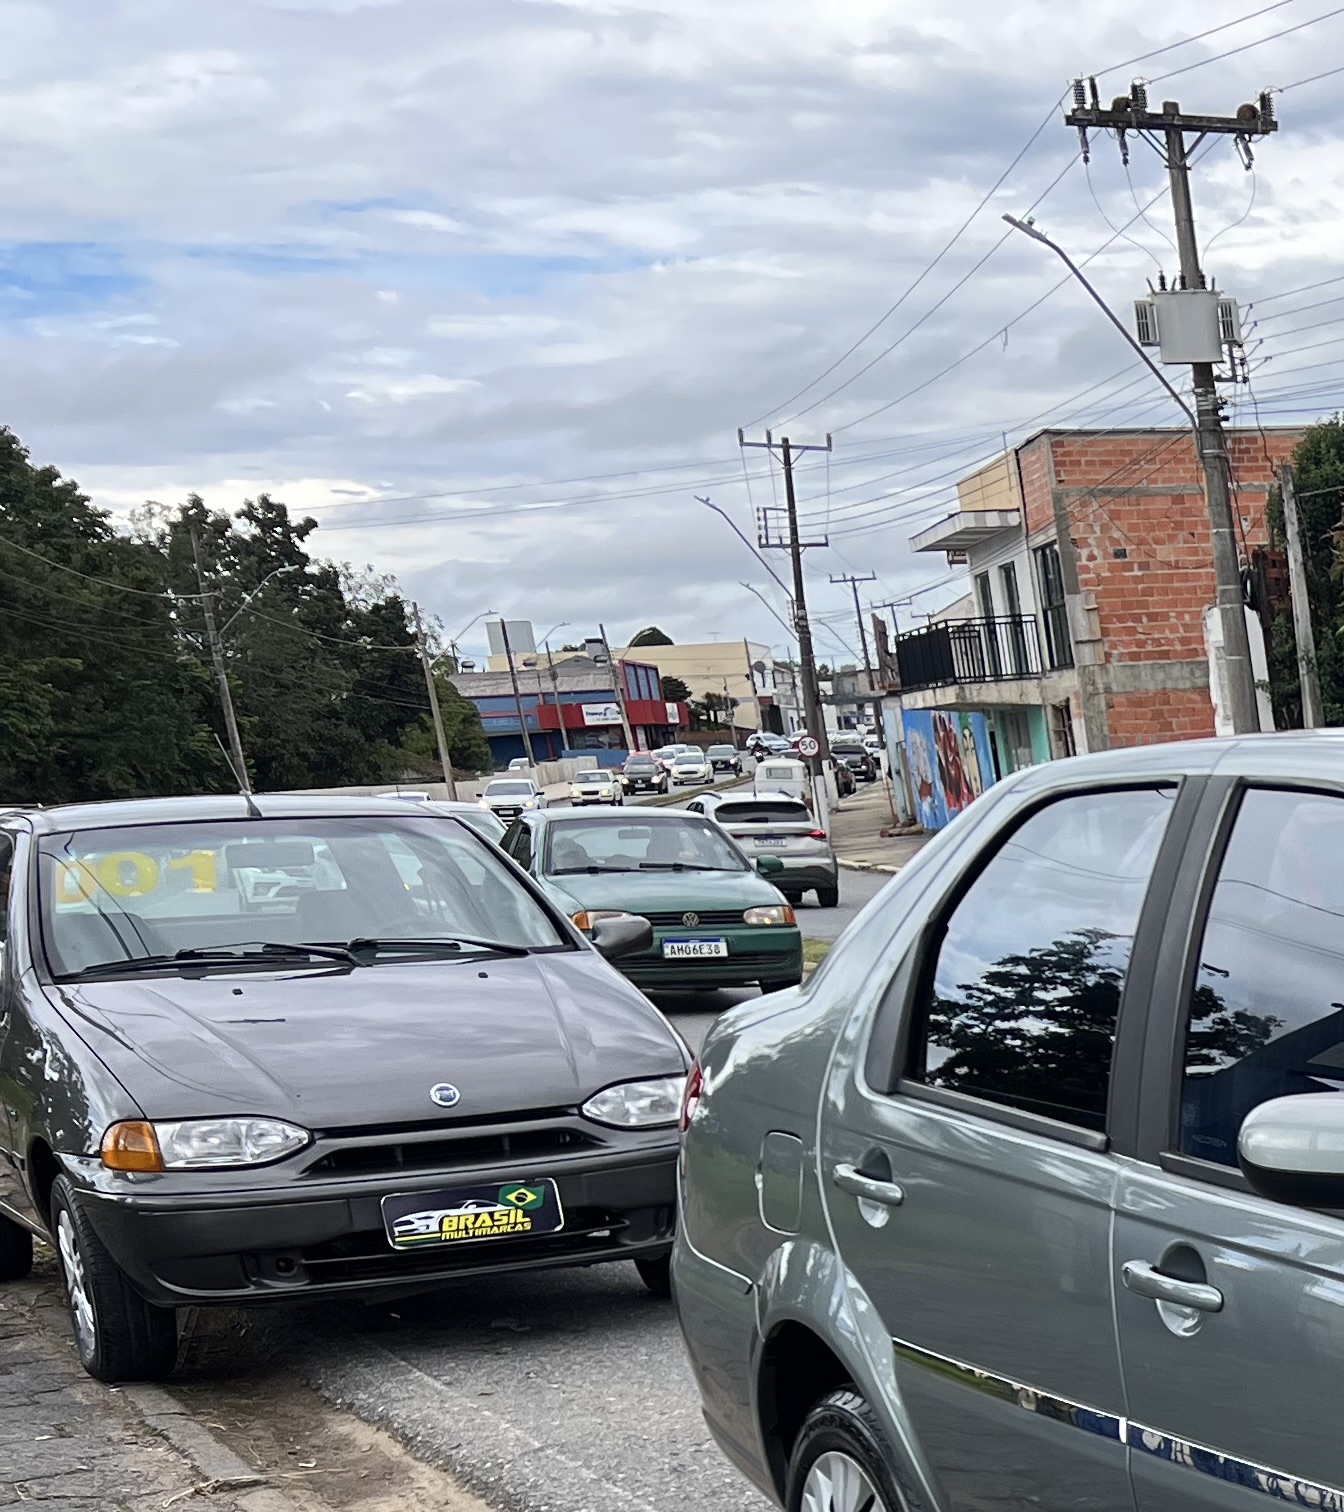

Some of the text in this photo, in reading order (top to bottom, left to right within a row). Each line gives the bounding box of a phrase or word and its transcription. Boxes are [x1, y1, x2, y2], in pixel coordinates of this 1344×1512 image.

[800, 740, 816, 750] 50
[442, 1208, 531, 1232] BRASIL
[441, 1222, 532, 1241] MULTIMARCAS
